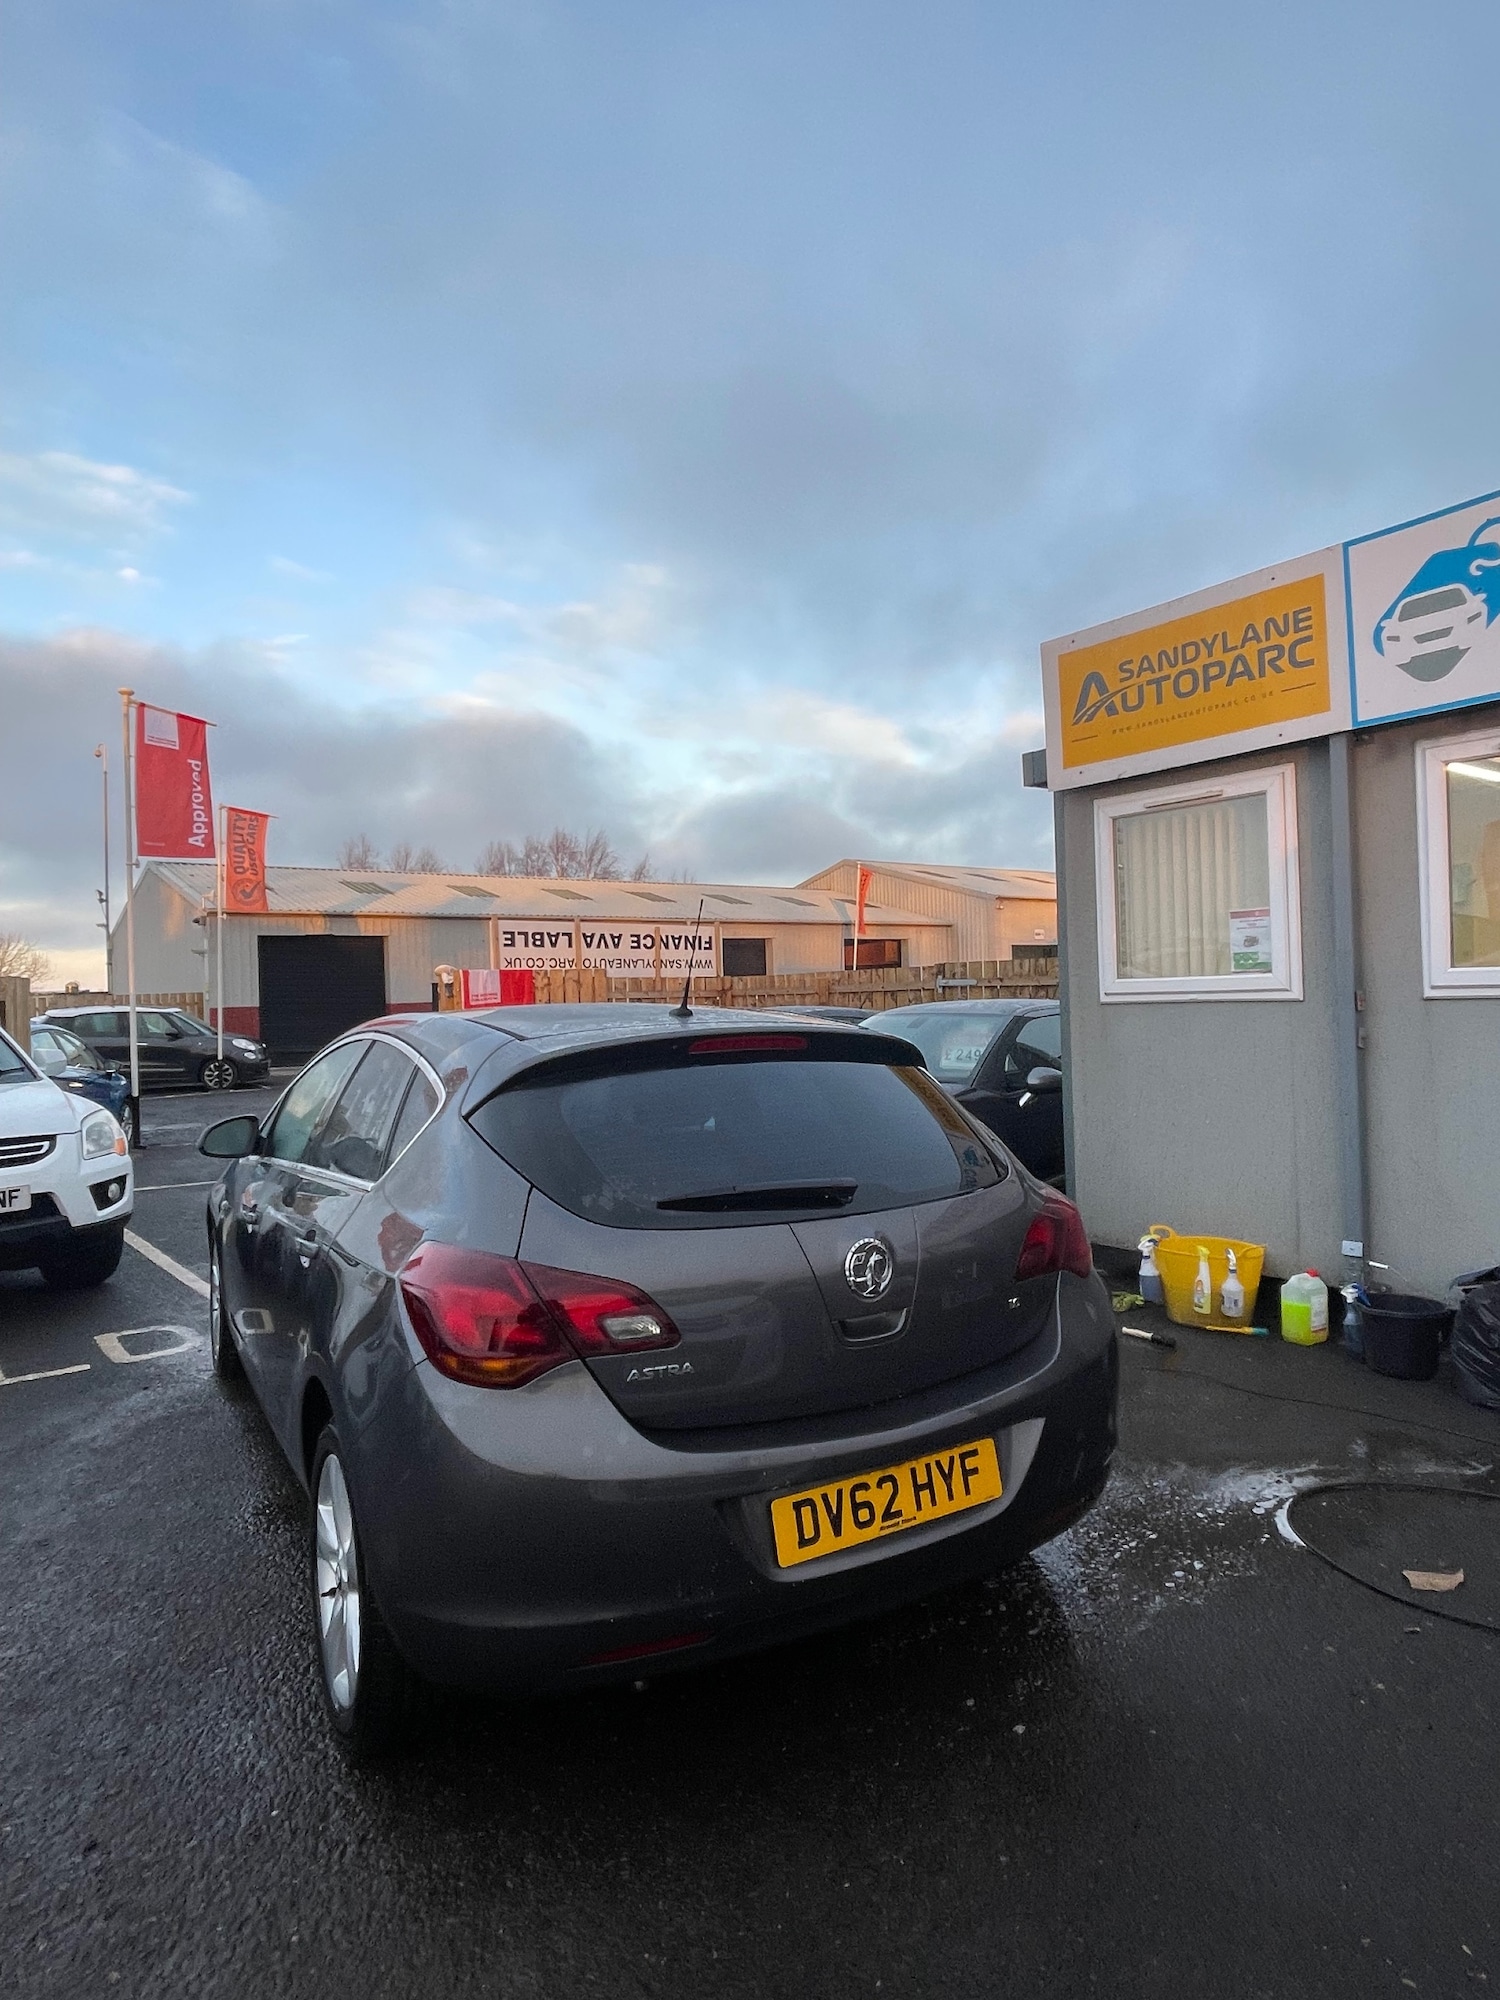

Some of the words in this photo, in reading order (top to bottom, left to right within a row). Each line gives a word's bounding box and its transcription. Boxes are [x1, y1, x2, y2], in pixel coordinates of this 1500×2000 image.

[1119, 606, 1313, 682] SANDYLANE
[1071, 634, 1315, 727] AUTOPARC
[187, 758, 209, 848] Approved
[232, 813, 248, 875] QUALITY
[246, 815, 260, 845] CARS
[247, 847, 259, 876] USED
[502, 930, 623, 949] AVALABLE
[630, 933, 713, 950] FINANCE
[626, 1362, 695, 1382] ASTRA
[792, 1473, 903, 1550] DV62
[909, 1448, 980, 1512] HYF
